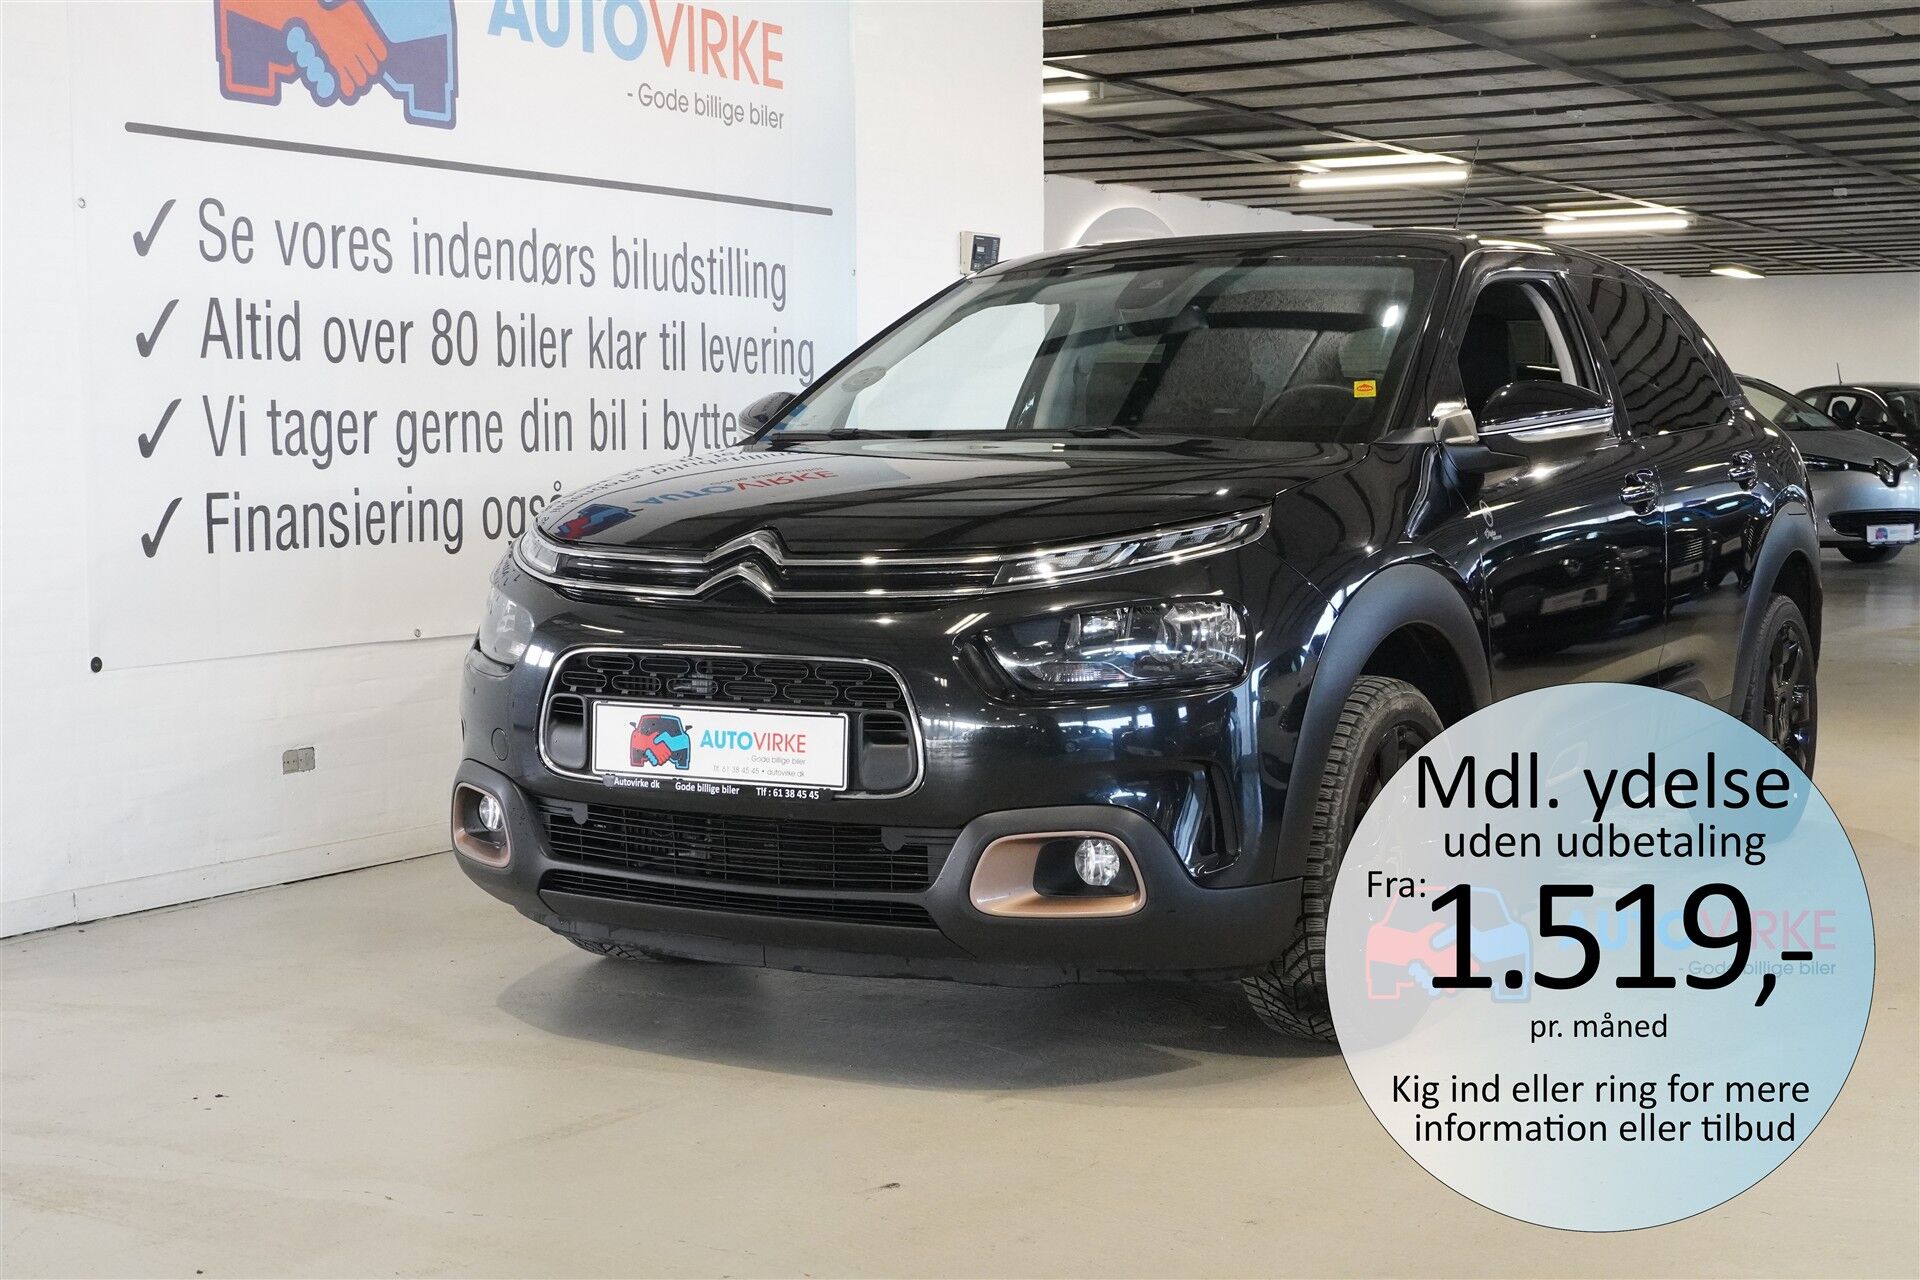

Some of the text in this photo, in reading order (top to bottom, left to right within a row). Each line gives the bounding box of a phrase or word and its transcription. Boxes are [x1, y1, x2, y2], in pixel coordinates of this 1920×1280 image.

[487, 0, 784, 90] AUTOVIRKE
[638, 82, 690, 113] Gode
[694, 91, 745, 127] billige
[749, 102, 785, 130] biler
[199, 197, 787, 312] Se vores indendørs biludstilling
[200, 297, 816, 386] Altid over 80 biler klar til levering
[202, 394, 738, 470] Vi tager gerne din bil i bytte
[206, 485, 464, 556] Finansiering
[482, 480, 563, 546] ogs
[700, 729, 806, 753] AUTOVIRKE
[751, 755, 771, 764] Gode
[791, 757, 806, 766] biler
[614, 777, 650, 789] Autovirke
[675, 781, 740, 795] Gode billige biler
[772, 789, 783, 798] 61
[785, 789, 796, 798] 38
[796, 790, 808, 799] 45
[809, 790, 820, 800] 45
